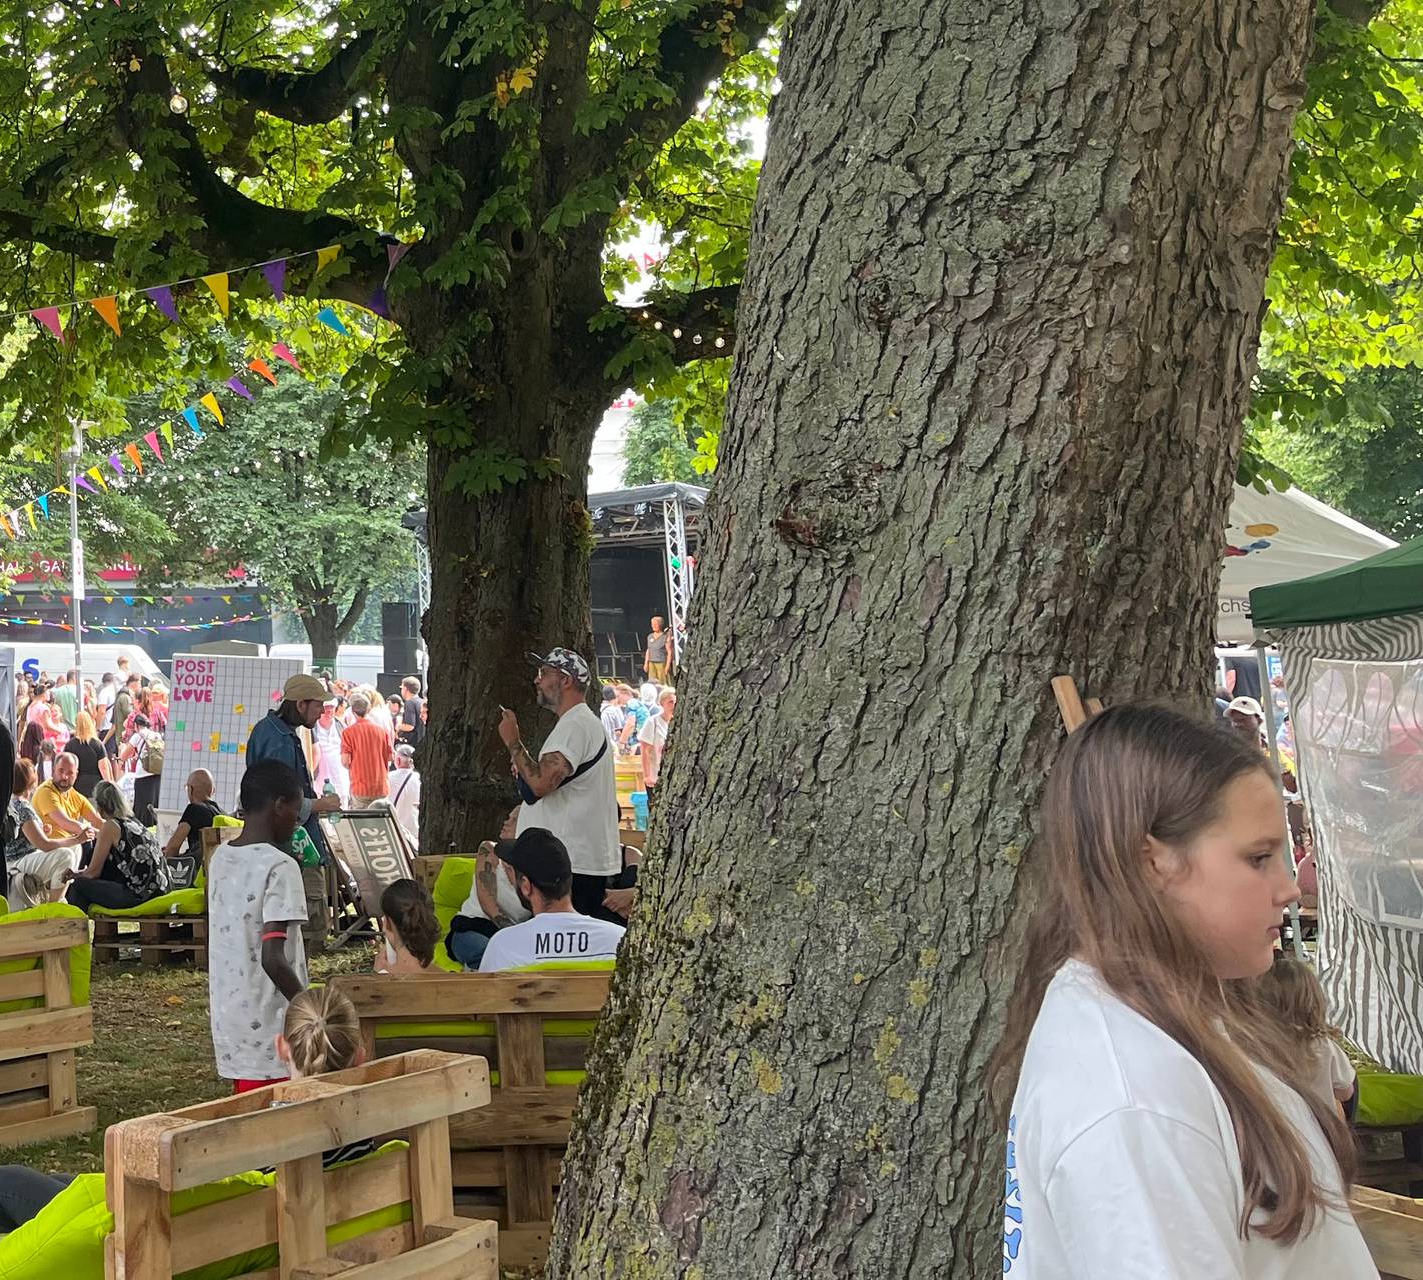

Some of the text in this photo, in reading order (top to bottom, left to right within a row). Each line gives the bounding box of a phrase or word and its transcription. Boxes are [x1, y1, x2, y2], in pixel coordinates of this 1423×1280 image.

[175, 660, 216, 673] POST
[175, 674, 215, 687] YOUR
[534, 930, 590, 955] MOTO
